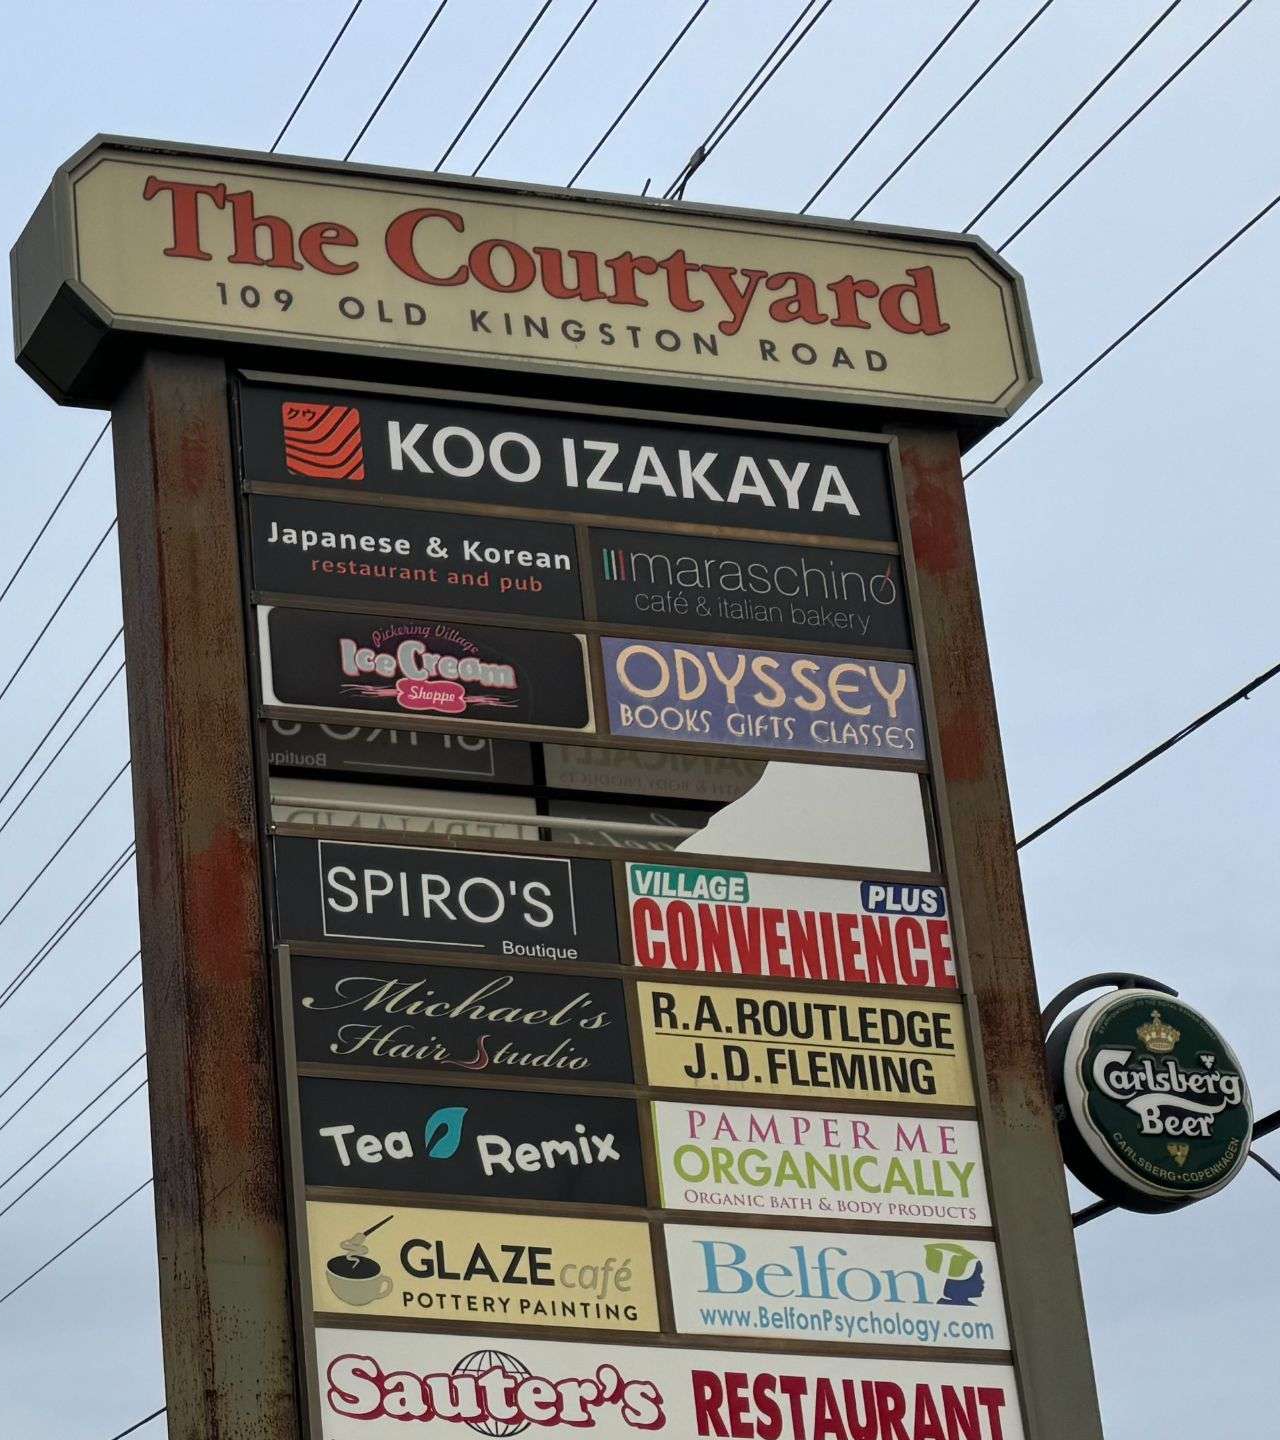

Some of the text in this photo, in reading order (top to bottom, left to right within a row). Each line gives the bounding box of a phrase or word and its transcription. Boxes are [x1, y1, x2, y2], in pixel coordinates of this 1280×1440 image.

[143, 175, 950, 336] The Courtyard
[216, 282, 889, 373] 109 OLD KINGSTON ROAD
[388, 420, 860, 516] KOO IZAKAYA
[268, 522, 571, 570] Japanese & Korean
[311, 558, 543, 592] restaurant and pub
[630, 552, 896, 605] maraschino
[635, 590, 871, 635] café & italian bakery
[371, 624, 479, 653] Pickering Village
[408, 685, 455, 704] Shoppe
[616, 644, 906, 718] ODYSSEY
[619, 704, 915, 750] BOOKS GIFTS CLASSES
[327, 865, 554, 928] SPIRO'S
[635, 869, 939, 913] VILLAGE PLUS
[502, 941, 578, 960] Boutique
[633, 897, 958, 989] CONVENIENCE
[302, 976, 613, 1029] Michael's
[330, 1024, 590, 1070] Hair Studio
[1093, 1049, 1241, 1107] Carlsberg
[686, 1109, 959, 1155] PAMPER ME
[1140, 1103, 1215, 1137] Beer
[319, 1123, 620, 1176] Tea Remix
[673, 1144, 976, 1199] ORGANICALLY
[770, 1195, 813, 1211] BATH
[819, 1197, 833, 1211] &
[838, 1199, 882, 1215] BODY
[889, 1202, 977, 1221] PRODUCTS
[400, 1238, 633, 1300] GLAZE café
[692, 1240, 933, 1305] Belfon
[403, 1291, 638, 1322] POTTERY PAINTING
[699, 1305, 994, 1342] www.BelfonPsychology.com
[327, 1353, 666, 1431] Sauter's
